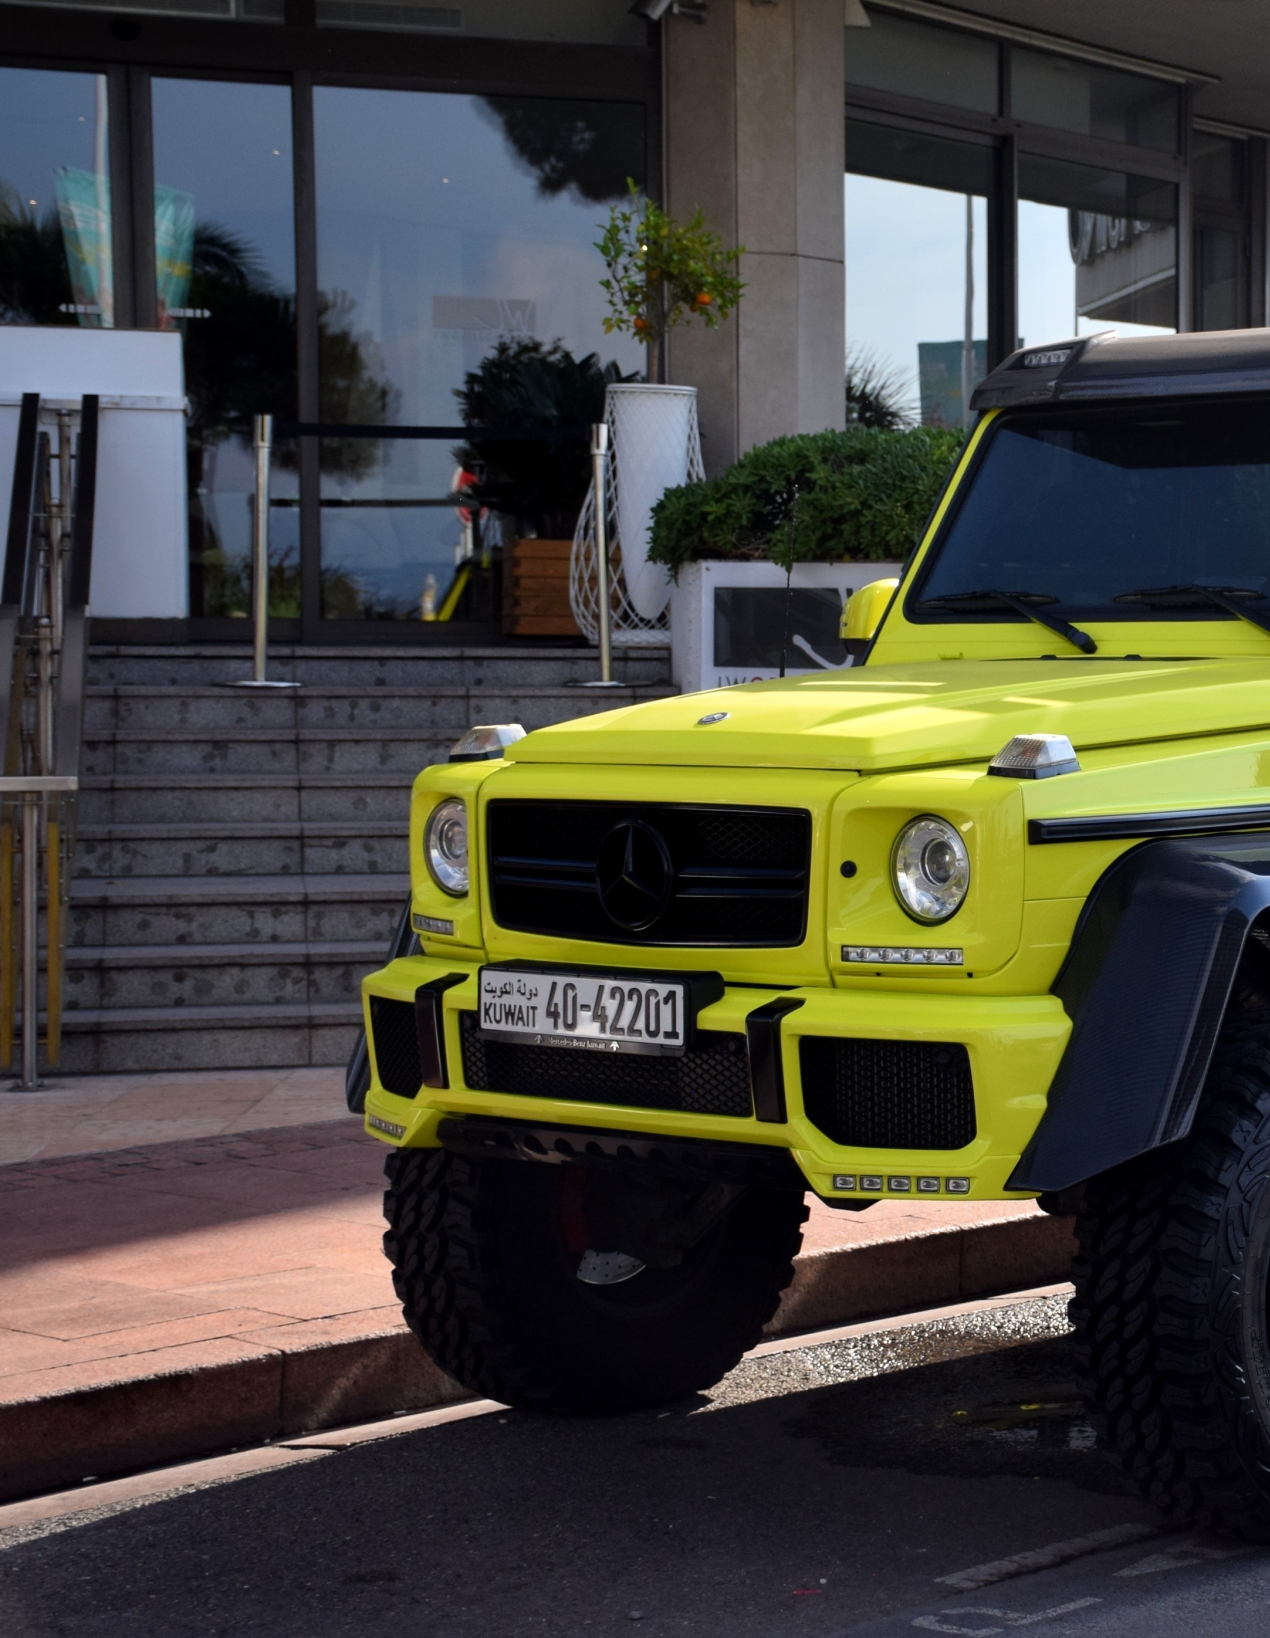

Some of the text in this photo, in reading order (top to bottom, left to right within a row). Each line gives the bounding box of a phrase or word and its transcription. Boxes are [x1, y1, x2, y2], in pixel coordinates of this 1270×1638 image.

[484, 979, 538, 1001] دولة الكويت
[484, 1002, 538, 1028] KUWAIT
[546, 981, 680, 1040] 40-42201
